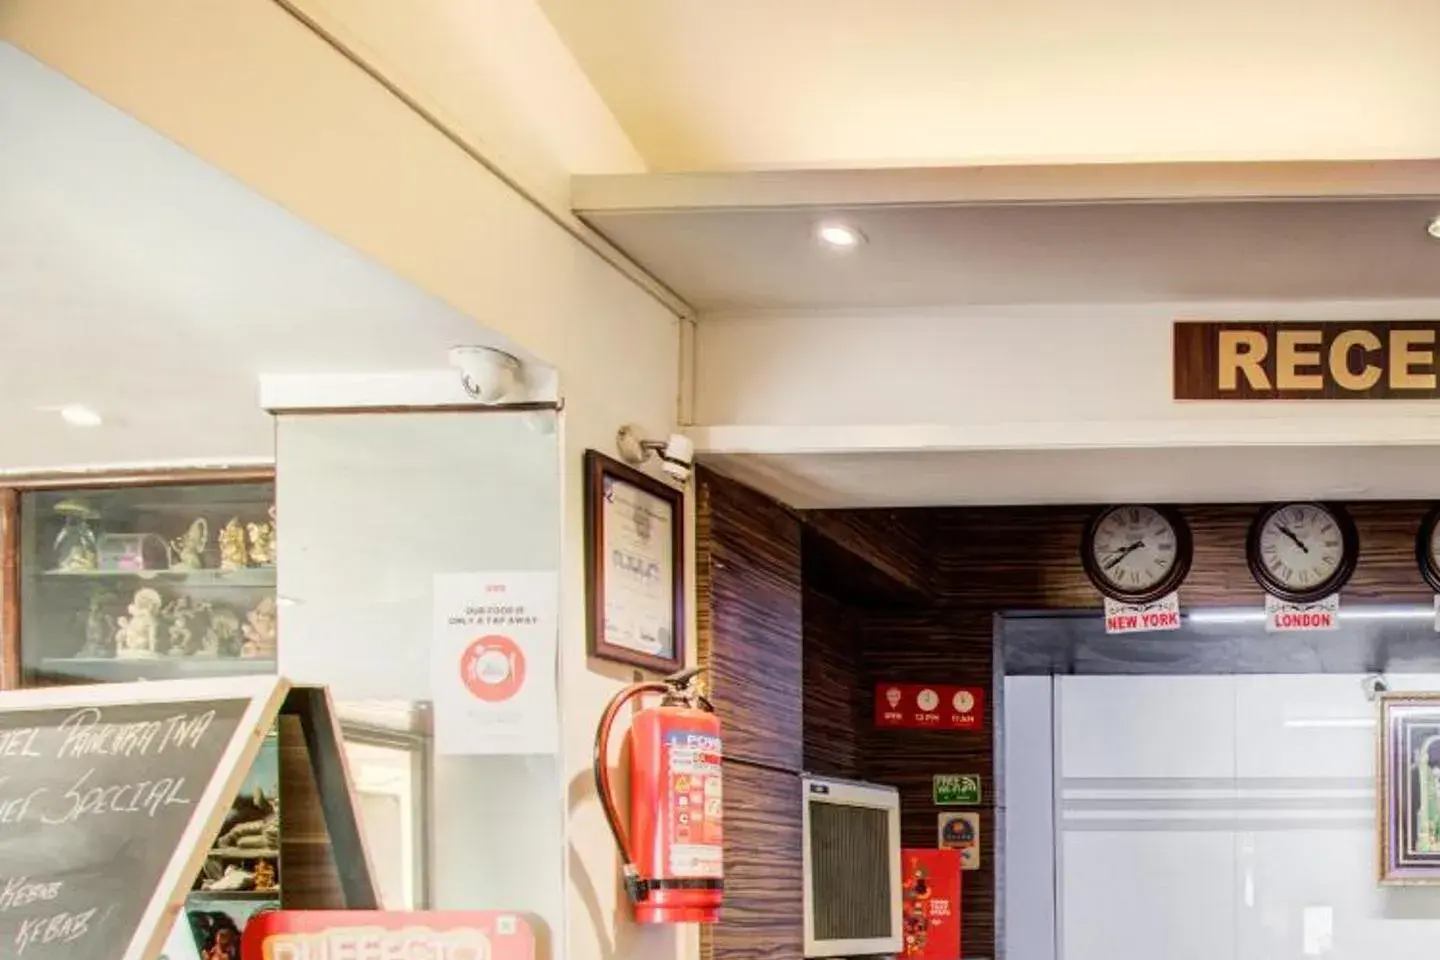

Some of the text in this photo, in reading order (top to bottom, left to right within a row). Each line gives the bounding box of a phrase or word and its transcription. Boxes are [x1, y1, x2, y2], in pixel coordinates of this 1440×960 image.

[508, 617, 538, 625] AWAY
[1108, 613, 1178, 630] NEW YORK
[1275, 614, 1331, 628] LONDON
